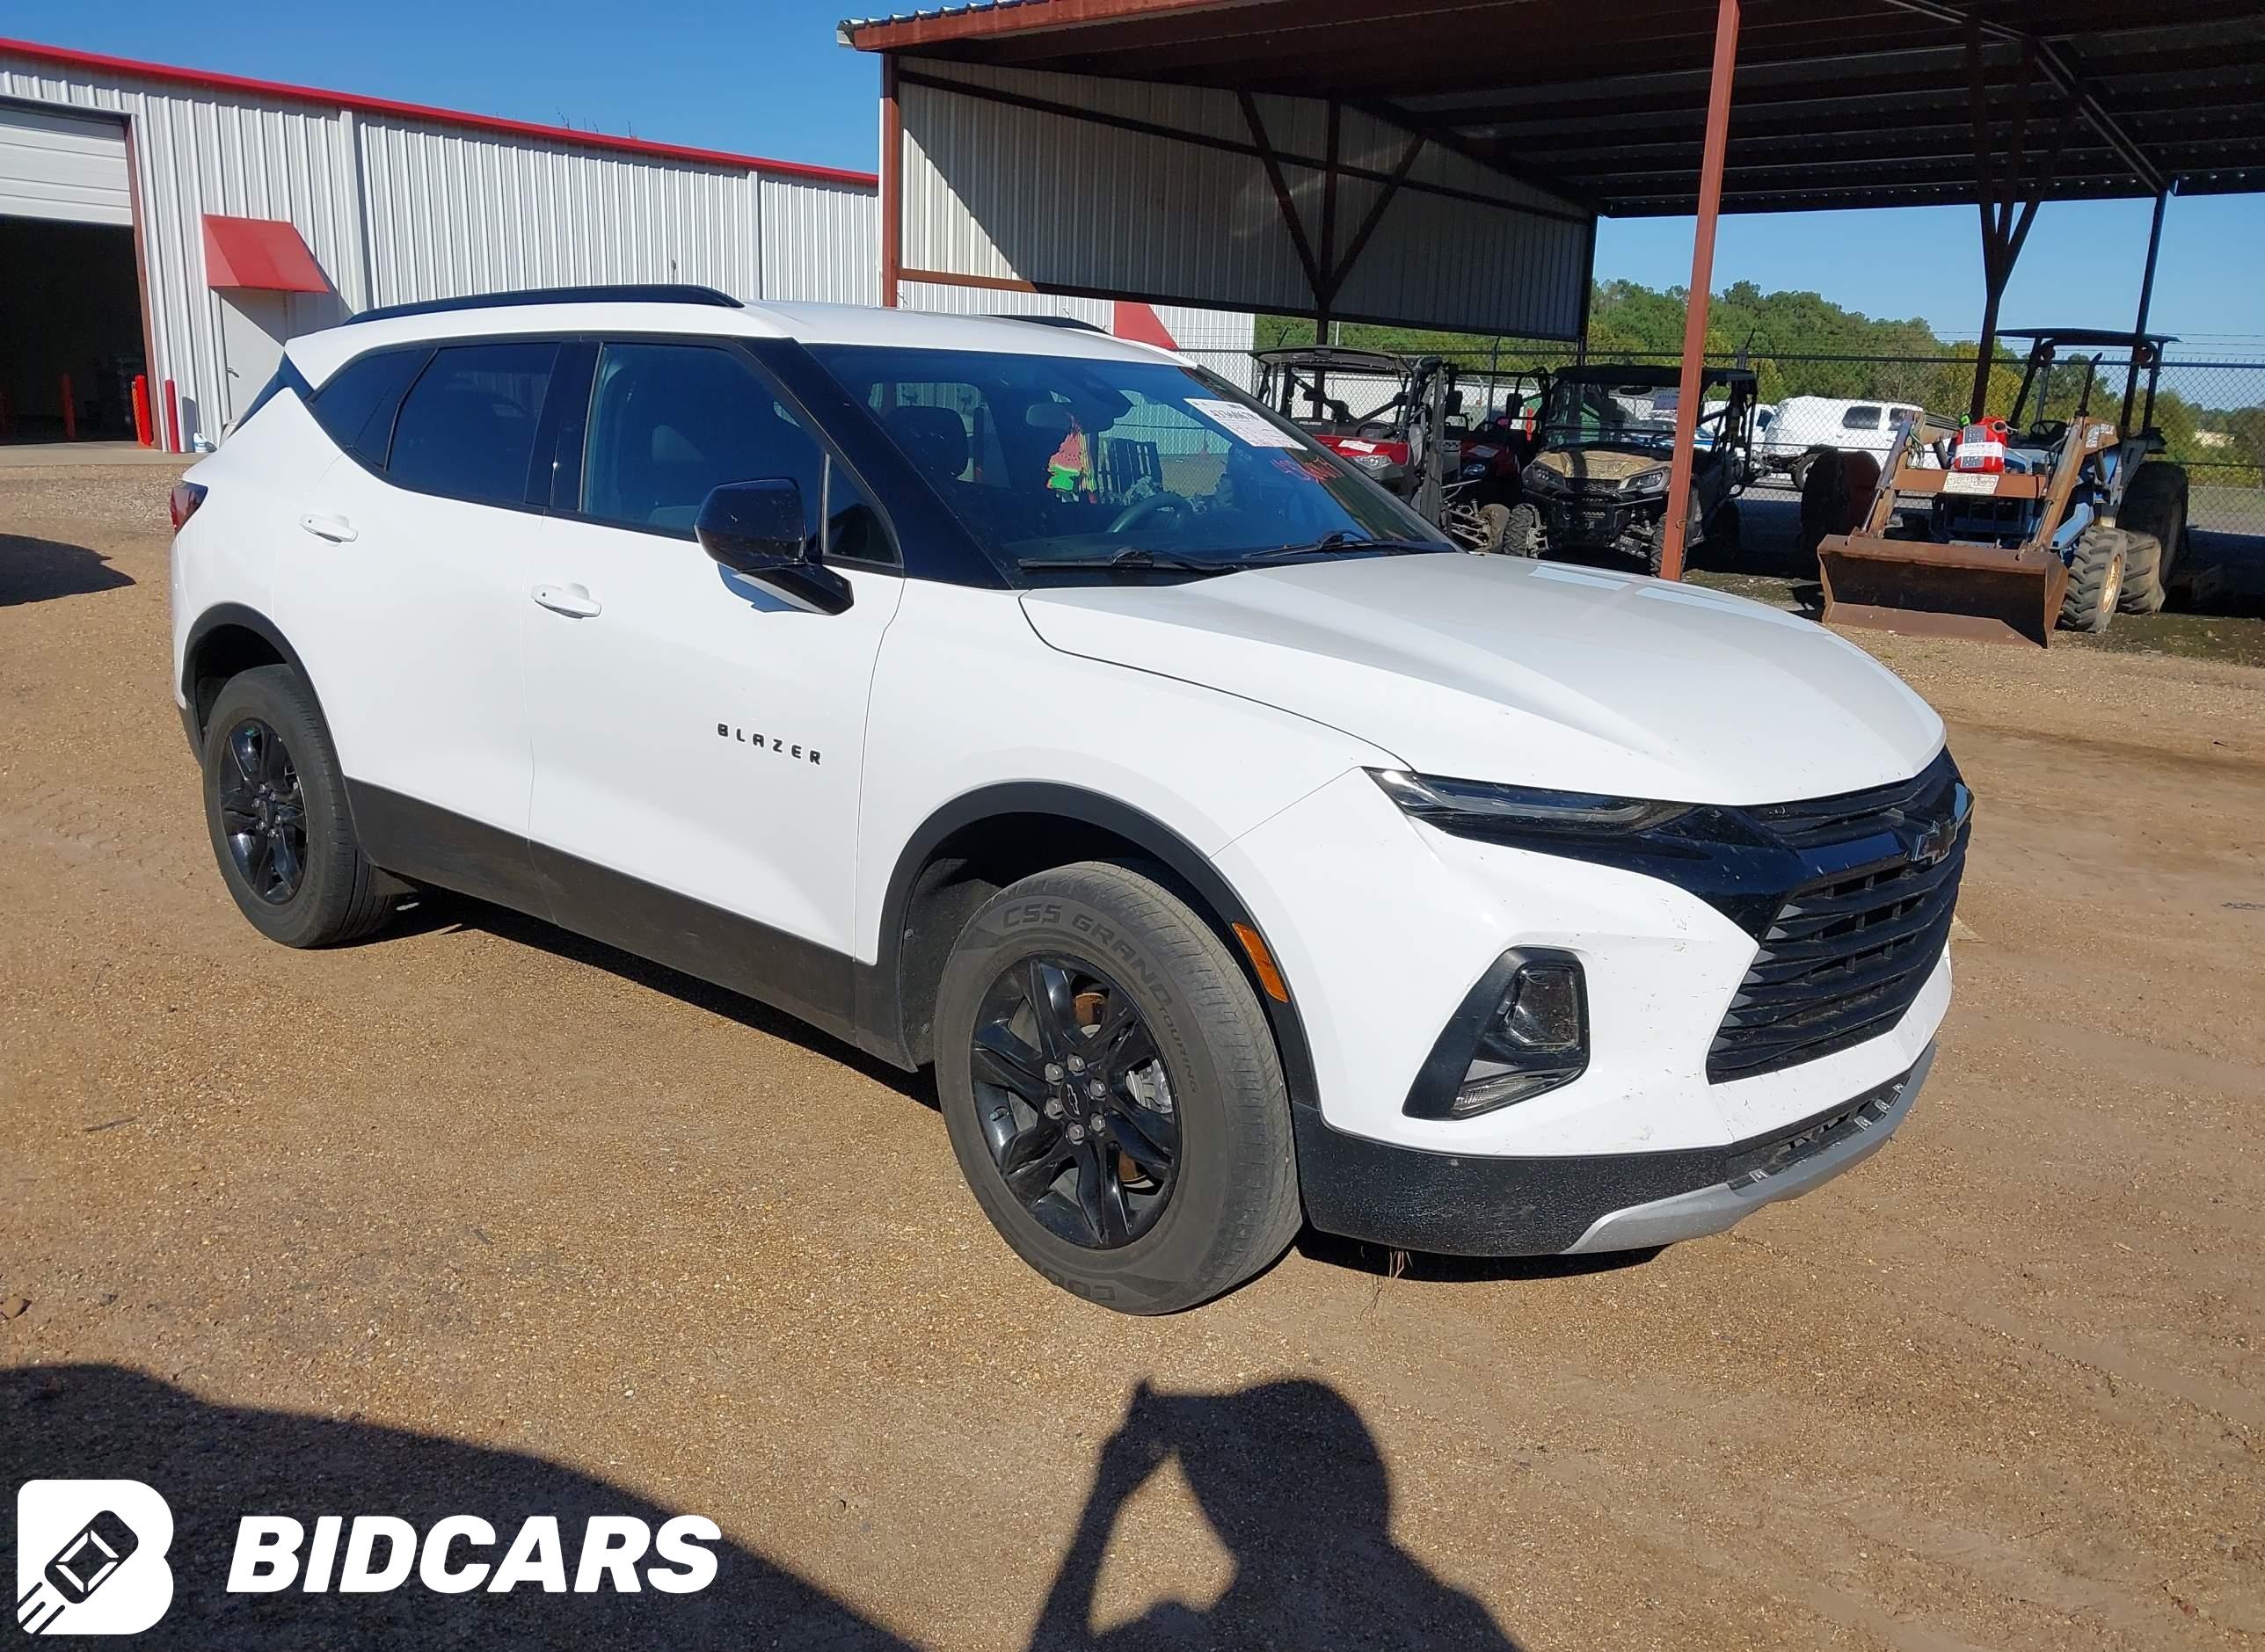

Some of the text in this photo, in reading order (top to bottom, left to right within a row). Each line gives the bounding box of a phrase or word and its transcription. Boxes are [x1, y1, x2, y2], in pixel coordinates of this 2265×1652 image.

[717, 723, 821, 766] BLAZER
[1002, 902, 1199, 1095] CS5 GRAND TOURING
